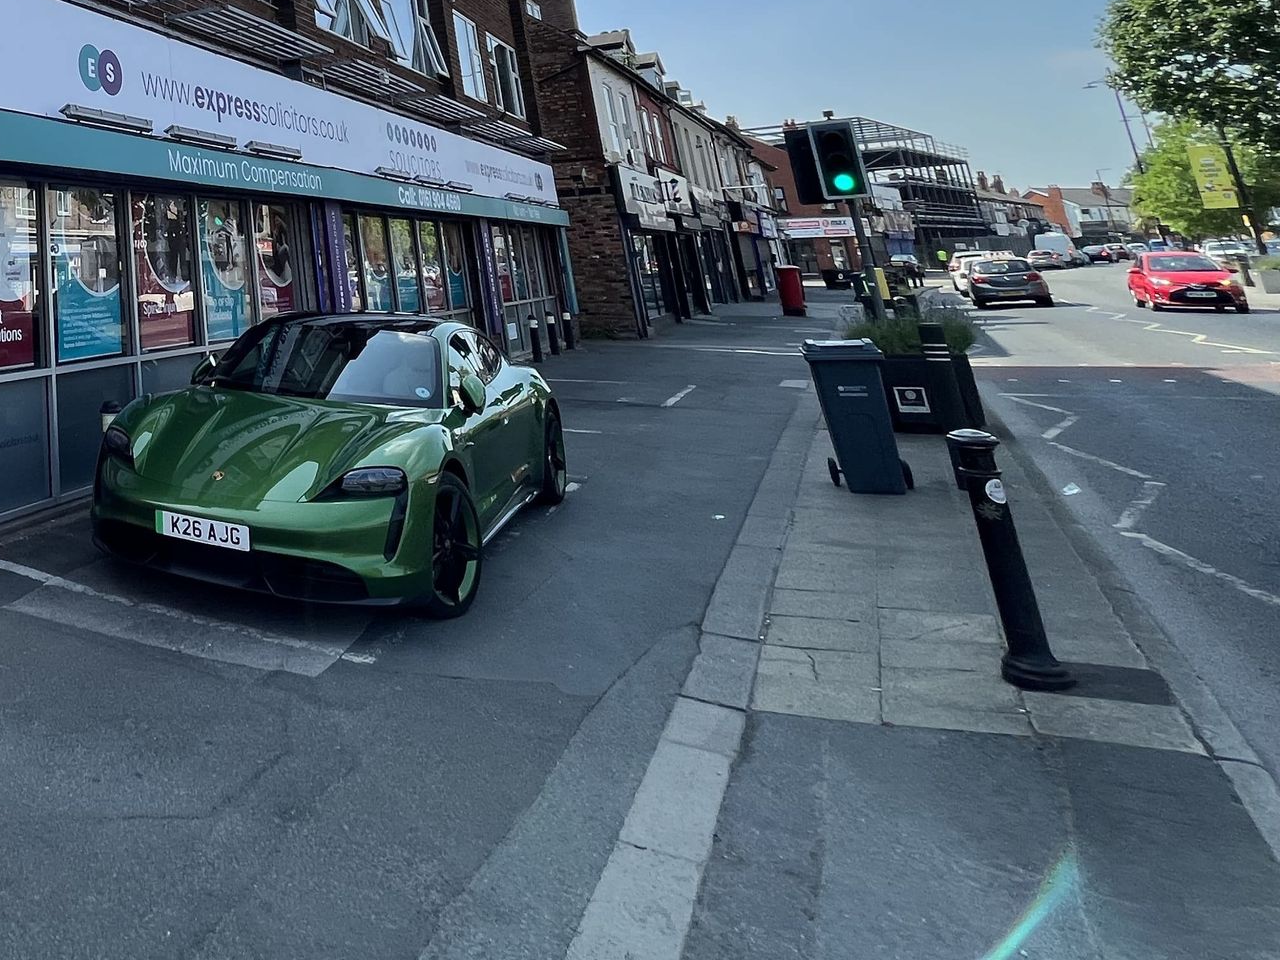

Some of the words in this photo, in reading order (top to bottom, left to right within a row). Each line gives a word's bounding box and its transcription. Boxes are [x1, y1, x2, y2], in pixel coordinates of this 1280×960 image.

[87, 57, 96, 78] E
[104, 62, 115, 83] S
[141, 71, 351, 144] www.expresssolicitors.co.uk
[167, 148, 239, 181] Maximum
[240, 160, 323, 192] Compensation
[390, 150, 442, 179] SOLICITORS
[171, 515, 202, 539] K26
[208, 523, 240, 546] AJG
